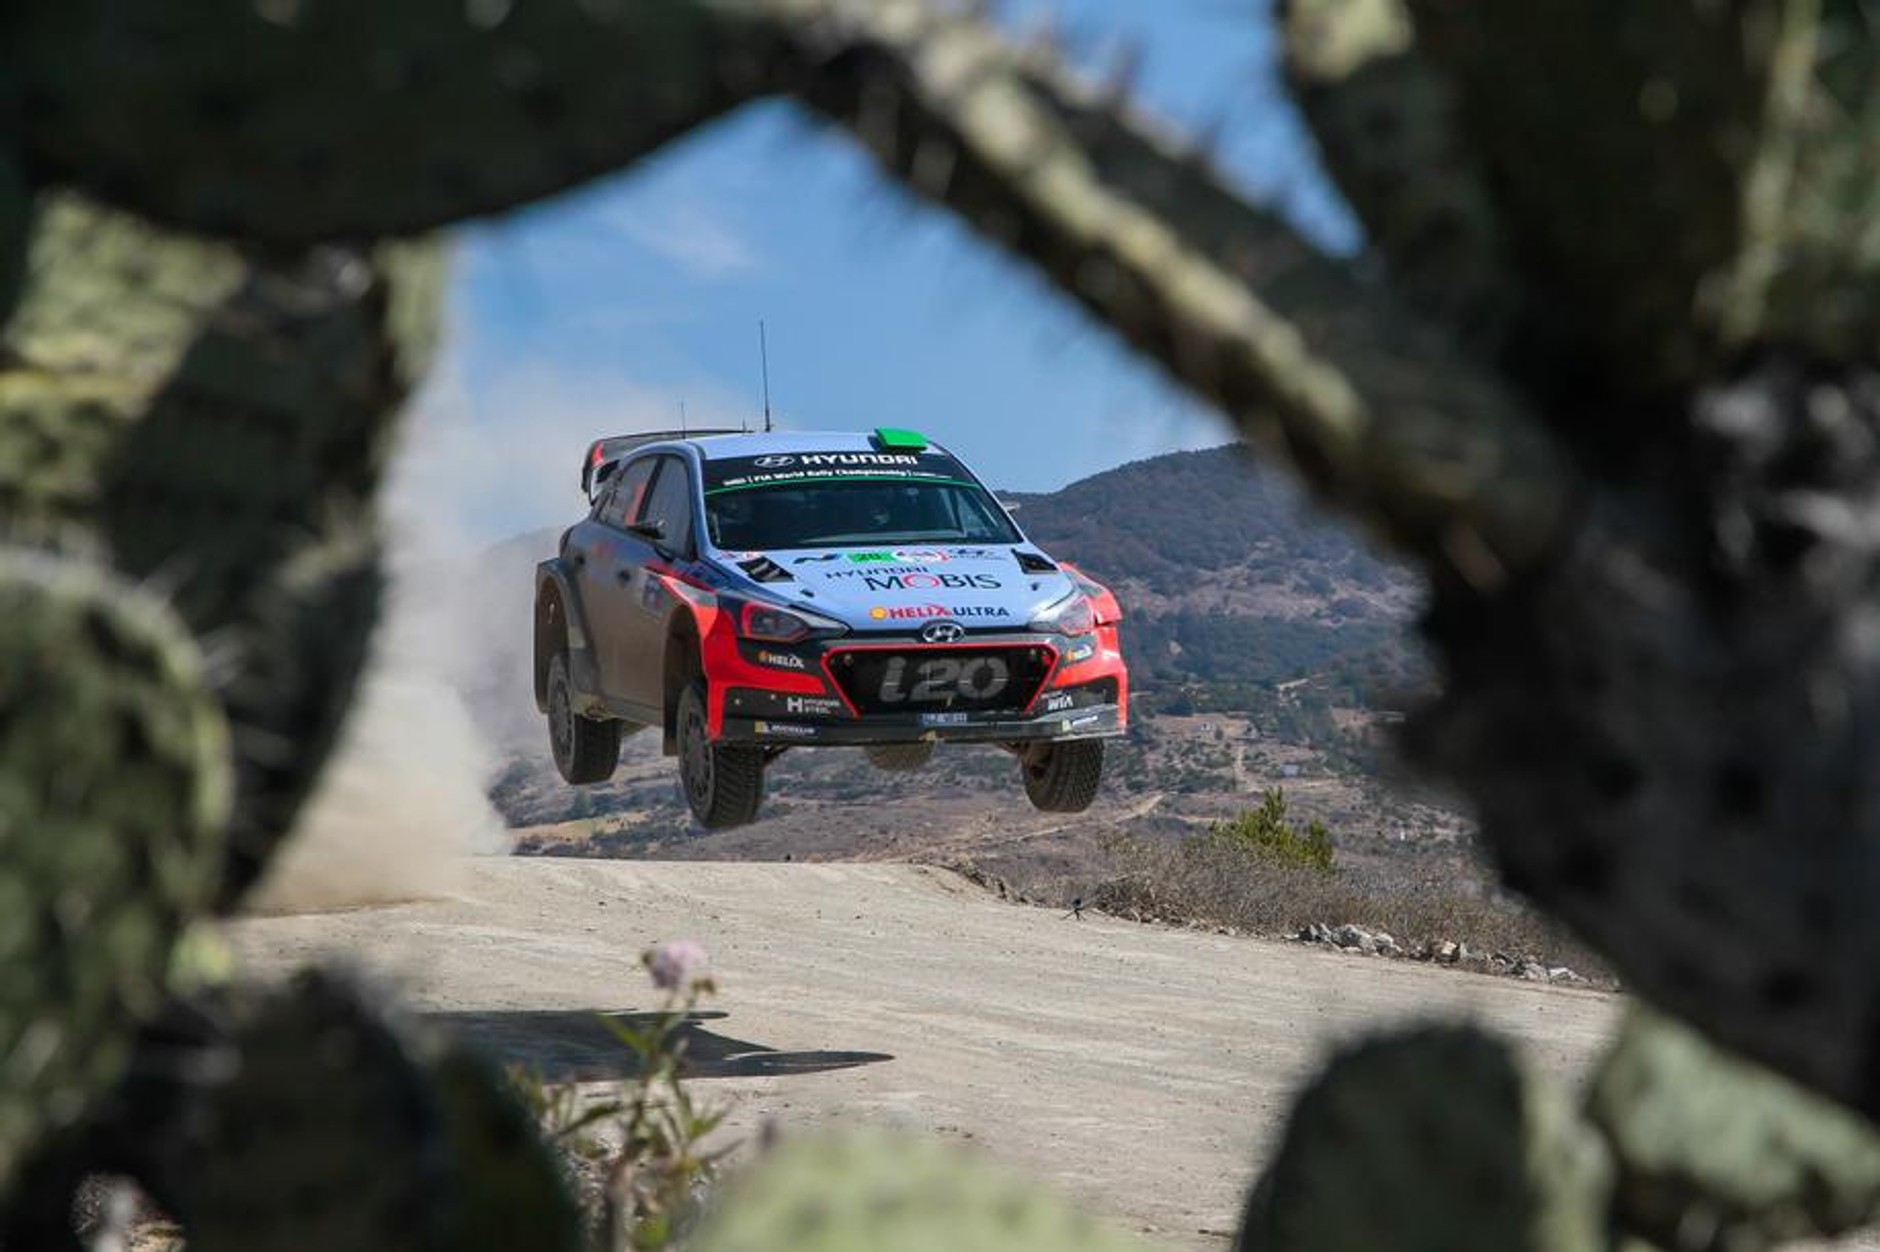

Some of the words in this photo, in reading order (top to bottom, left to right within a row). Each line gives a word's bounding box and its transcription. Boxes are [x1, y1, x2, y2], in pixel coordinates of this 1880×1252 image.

[801, 454, 919, 465] HYUNDAI
[773, 471, 805, 480] World
[806, 469, 834, 477] Rally
[835, 468, 907, 477] Championship
[825, 566, 930, 579] HYUNDAI
[864, 573, 1002, 592] MOBIS
[889, 602, 951, 620] HELIX
[952, 606, 1010, 617] ULTRA
